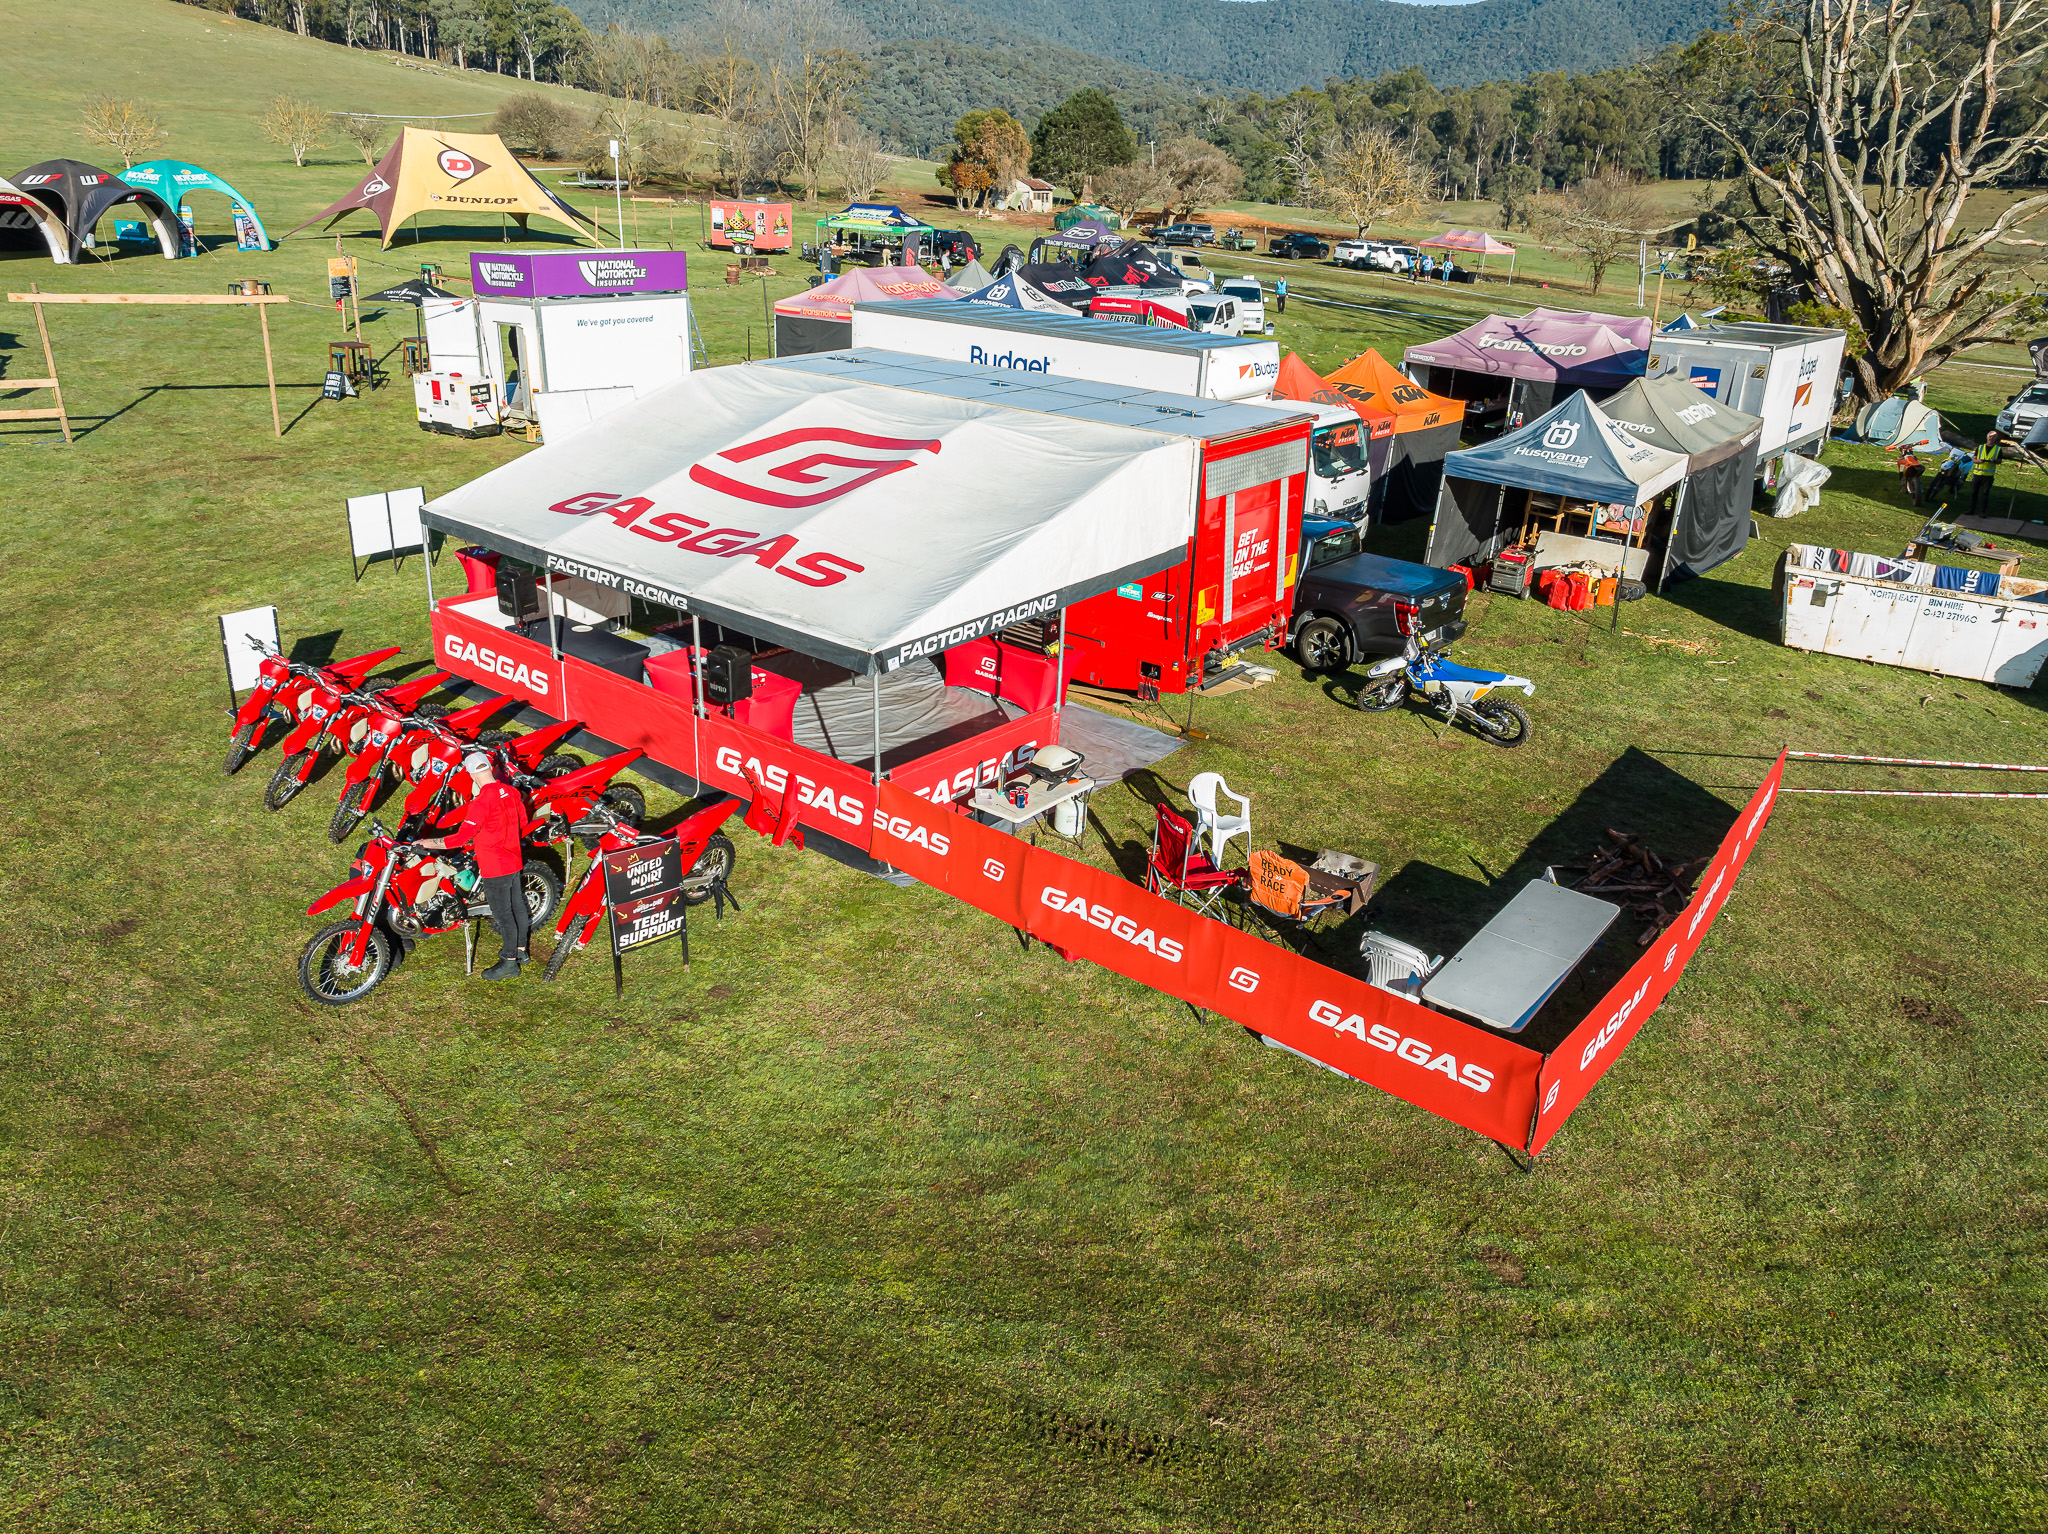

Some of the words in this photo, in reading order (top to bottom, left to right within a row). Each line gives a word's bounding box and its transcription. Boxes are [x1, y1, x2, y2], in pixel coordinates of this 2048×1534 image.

[79, 174, 109, 186] WP
[126, 171, 162, 181] MOTOREX
[172, 173, 210, 181] MOTOREX
[445, 195, 518, 205] DUNLOP
[491, 263, 516, 273] NATIONAL
[597, 259, 636, 270] NATIONAL
[597, 268, 647, 279] MOTORCYCLE
[491, 272, 524, 282] MOTORCYCLE
[597, 278, 635, 287] INSURANCE
[876, 281, 942, 297] transmoto
[577, 318, 598, 327] We've
[599, 318, 611, 326] got
[612, 318, 625, 326] you
[626, 315, 654, 324] covered
[802, 307, 836, 318] transmoto
[1477, 333, 1588, 357] transmoto
[1409, 351, 1436, 362] transmoto
[1332, 382, 1376, 402] TM
[1391, 384, 1430, 404] KTM
[1377, 421, 1391, 431] KTM
[1423, 412, 1440, 426] KTM
[1513, 446, 1590, 464] Husqvarna
[548, 492, 865, 588] GASGAS
[1238, 528, 1258, 548] GET
[1234, 546, 1250, 564] ON
[1250, 538, 1270, 558] THE
[1232, 559, 1254, 580] GAS!
[546, 555, 621, 588] FACTORY
[623, 578, 688, 611] RACING
[1870, 589, 1897, 602] NORTH
[1898, 593, 1919, 604] EAST
[1928, 598, 1943, 608] BIN
[1944, 601, 1964, 611] HIRE
[899, 617, 990, 664] FACTORY
[991, 594, 1057, 631] RACING
[444, 634, 549, 695] GASGAS
[716, 746, 864, 827] GASGAS
[626, 856, 663, 879] UNITED
[631, 876, 640, 886] IN
[640, 867, 664, 887] DIRT
[1261, 858, 1293, 877] READY
[1262, 869, 1274, 880] TO
[1260, 876, 1286, 895] RACE
[632, 910, 670, 931] TECH
[1040, 886, 1184, 963] GASGAS
[619, 916, 684, 948] SUPPORT
[1579, 975, 1652, 1072] GASGAS
[1308, 999, 1495, 1093] GASGAS
